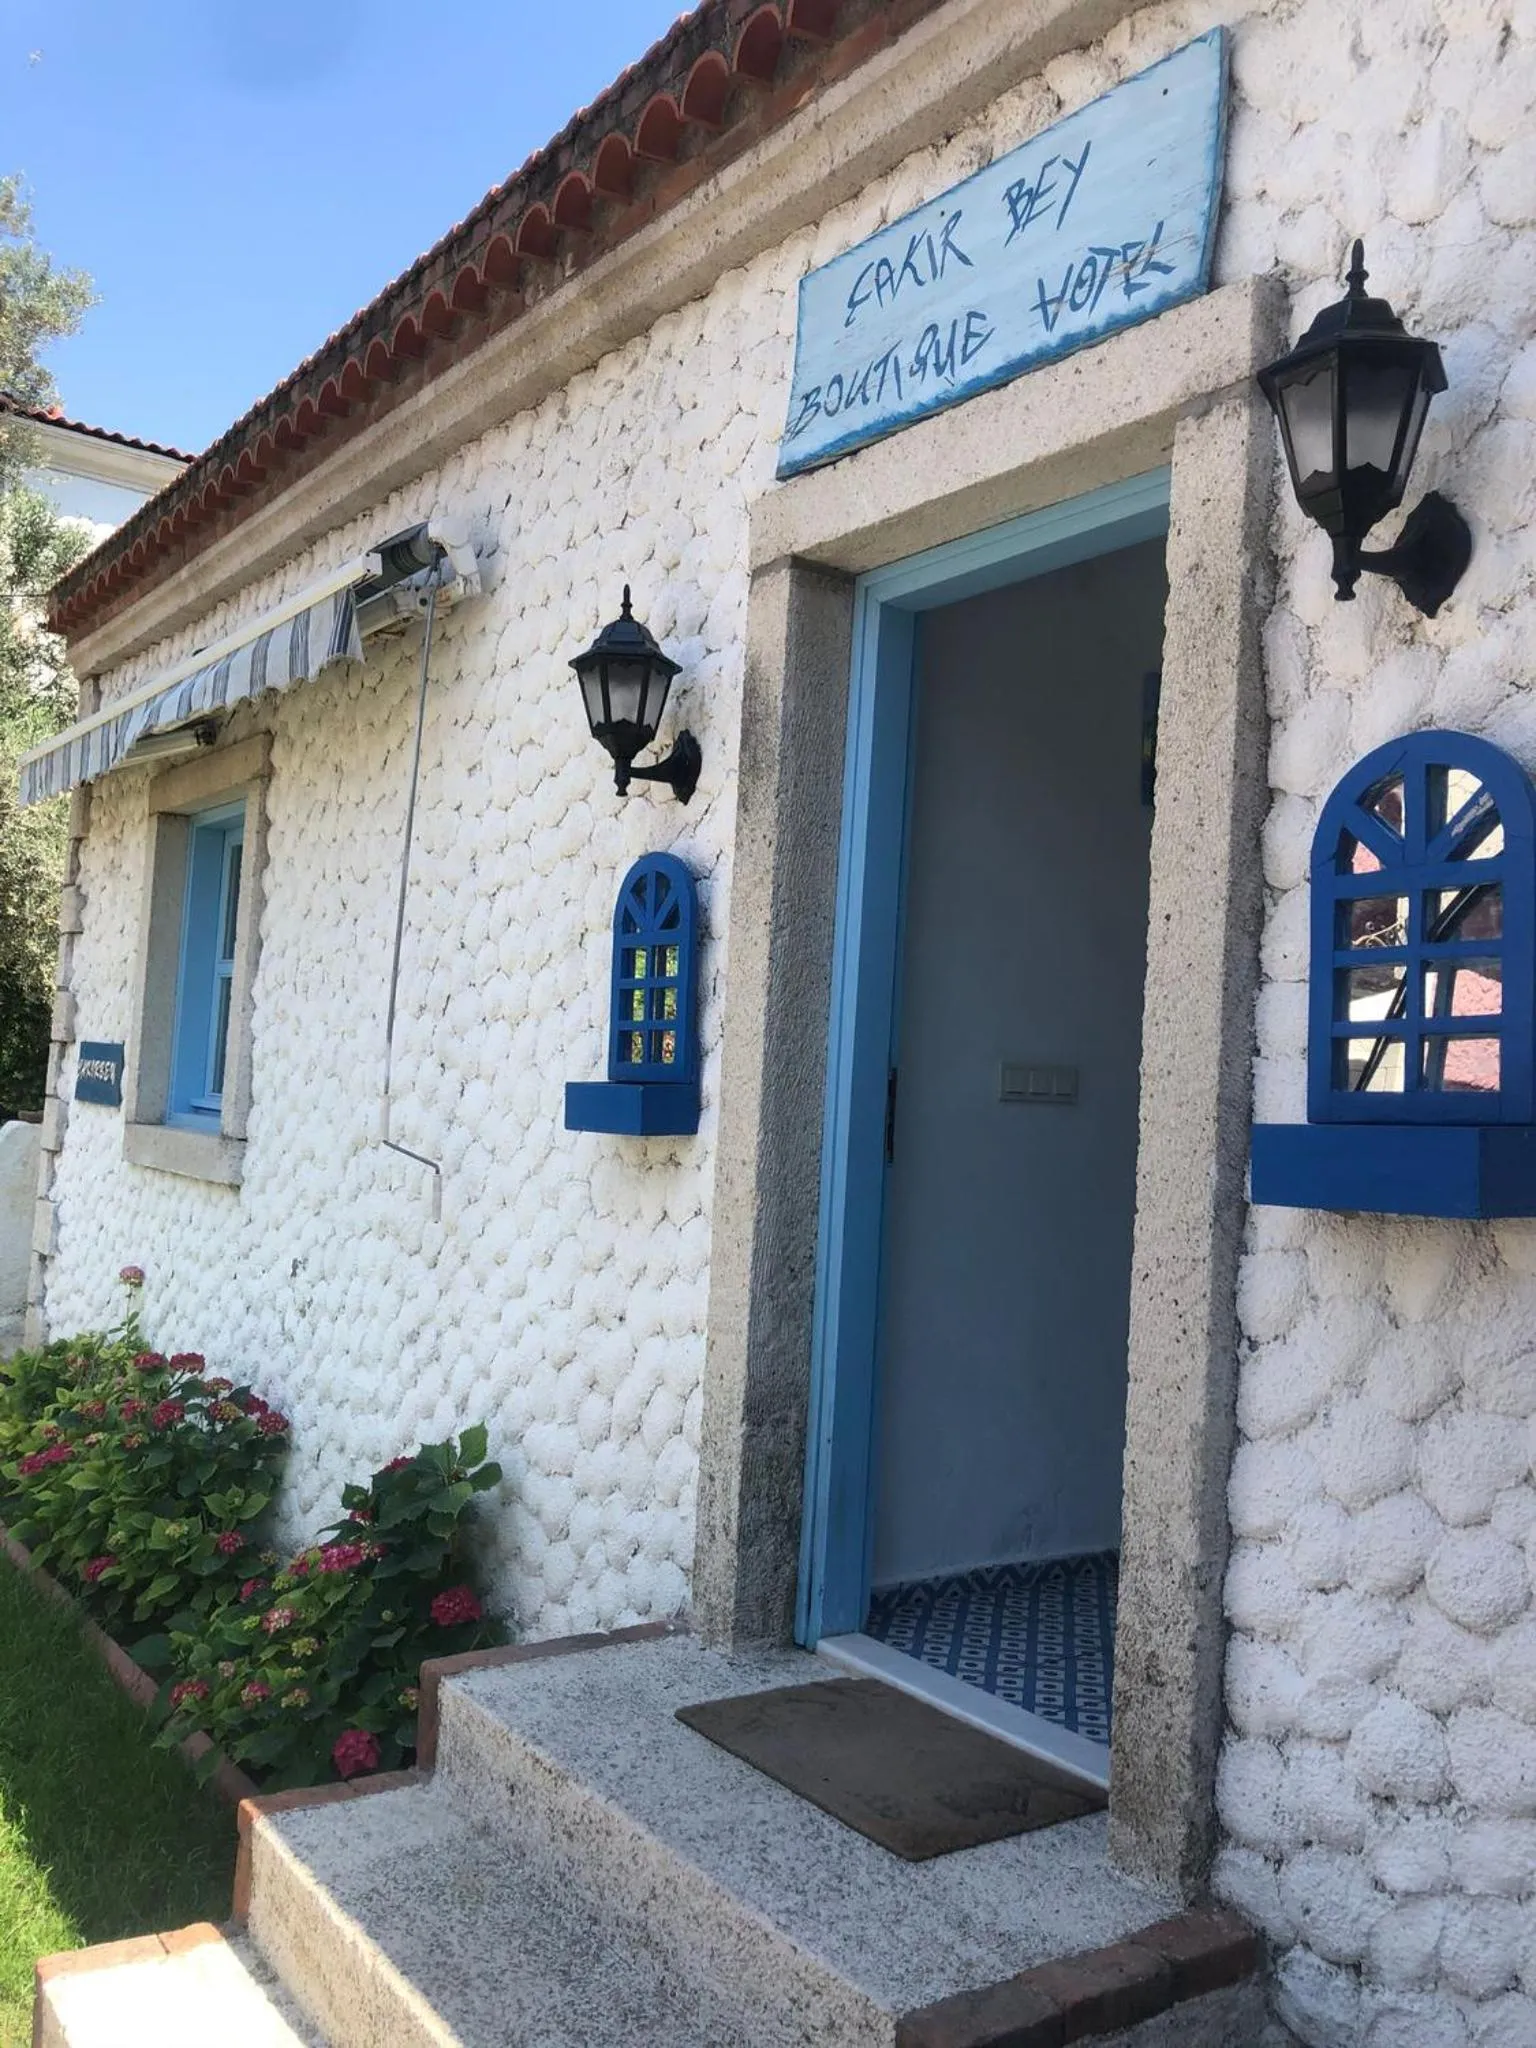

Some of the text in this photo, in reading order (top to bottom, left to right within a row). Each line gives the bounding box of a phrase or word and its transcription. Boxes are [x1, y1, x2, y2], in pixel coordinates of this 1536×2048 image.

[1004, 141, 1092, 248] BEY
[784, 219, 1178, 442] BOUTIQUE HOTEL
